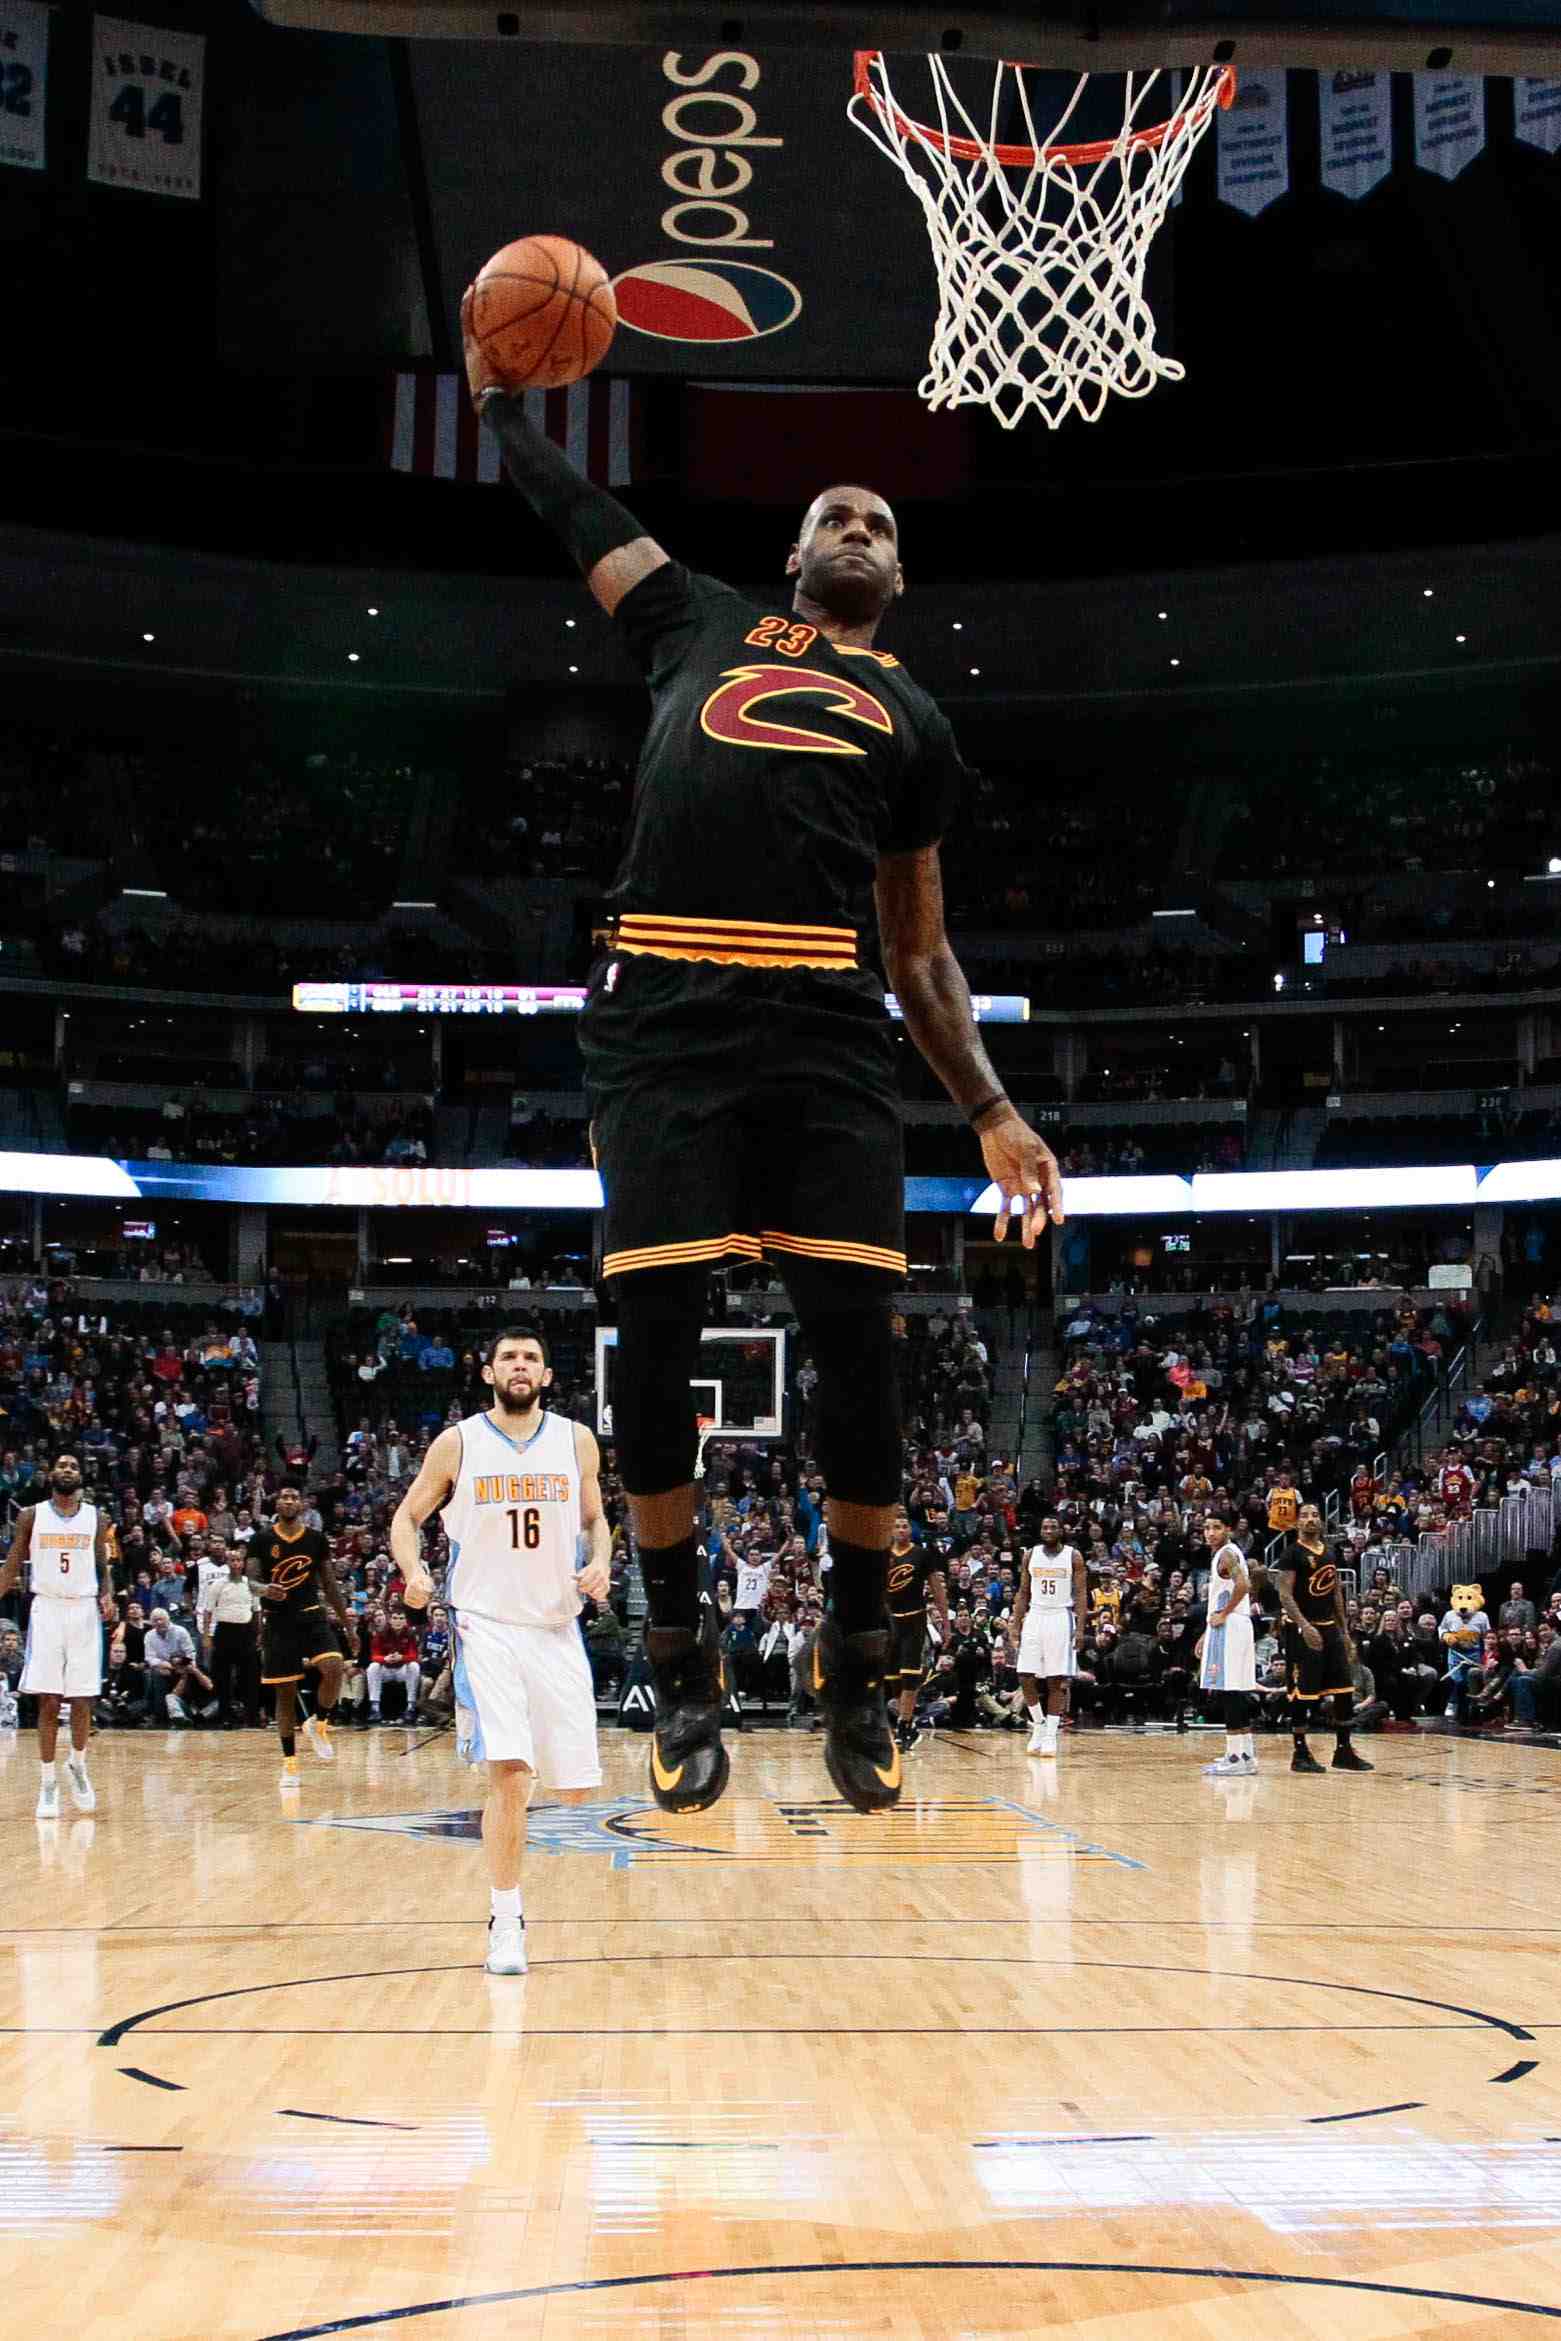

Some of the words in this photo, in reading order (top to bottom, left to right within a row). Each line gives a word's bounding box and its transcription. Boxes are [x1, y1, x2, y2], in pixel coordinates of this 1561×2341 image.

[109, 84, 183, 144] 44
[661, 50, 784, 249] peps
[743, 615, 818, 658] 23
[320, 1167, 475, 1206] ASOLUT
[473, 1472, 570, 1506] NUGGETS
[505, 1507, 540, 1551] 16
[58, 1552, 71, 1574] 5
[745, 1578, 758, 1591] 23
[1040, 1579, 1057, 1596] 35
